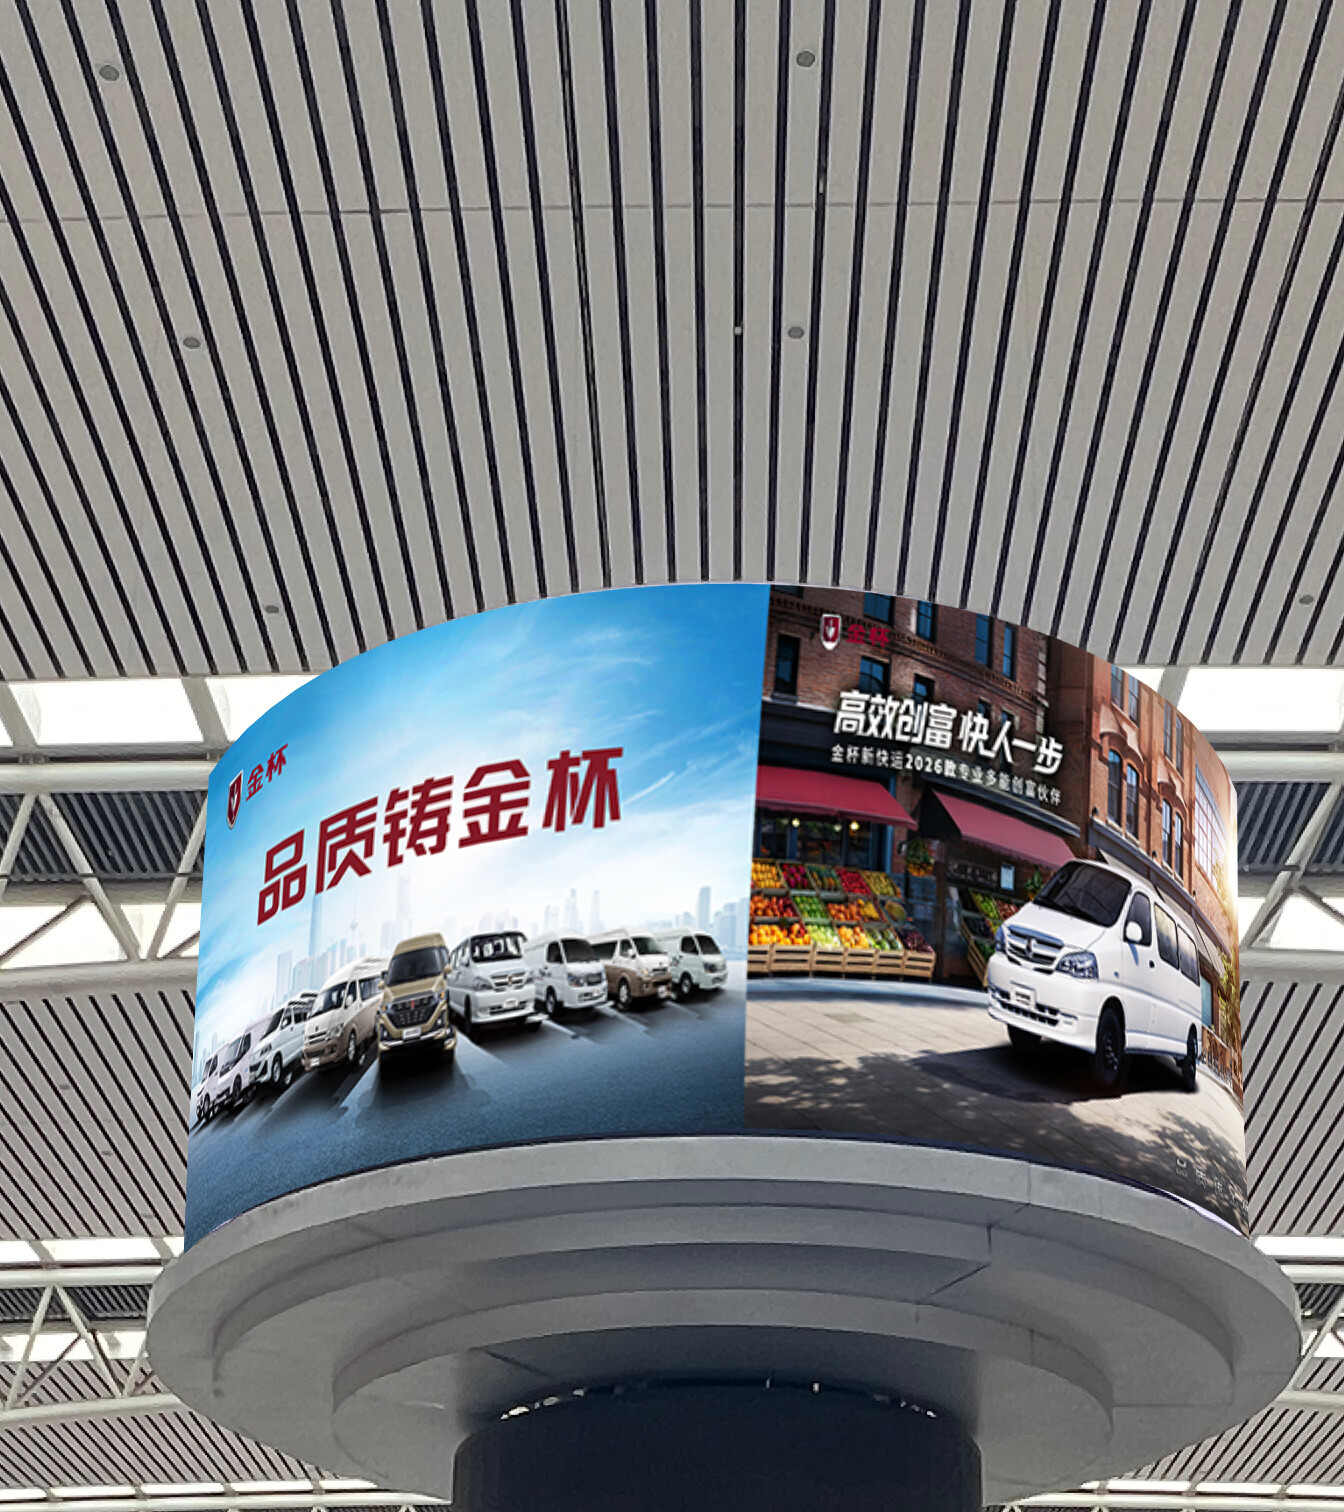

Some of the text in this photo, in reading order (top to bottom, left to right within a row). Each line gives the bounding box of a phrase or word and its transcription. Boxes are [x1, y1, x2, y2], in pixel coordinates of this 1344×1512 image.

[845, 624, 891, 648] 金杯
[833, 690, 1064, 775] 高效创富 快人一步
[245, 743, 289, 800] 金杯
[830, 744, 1062, 806] 金杯新快运2026款专业多能创富伙伴
[257, 747, 623, 926] 品质铸金杯
